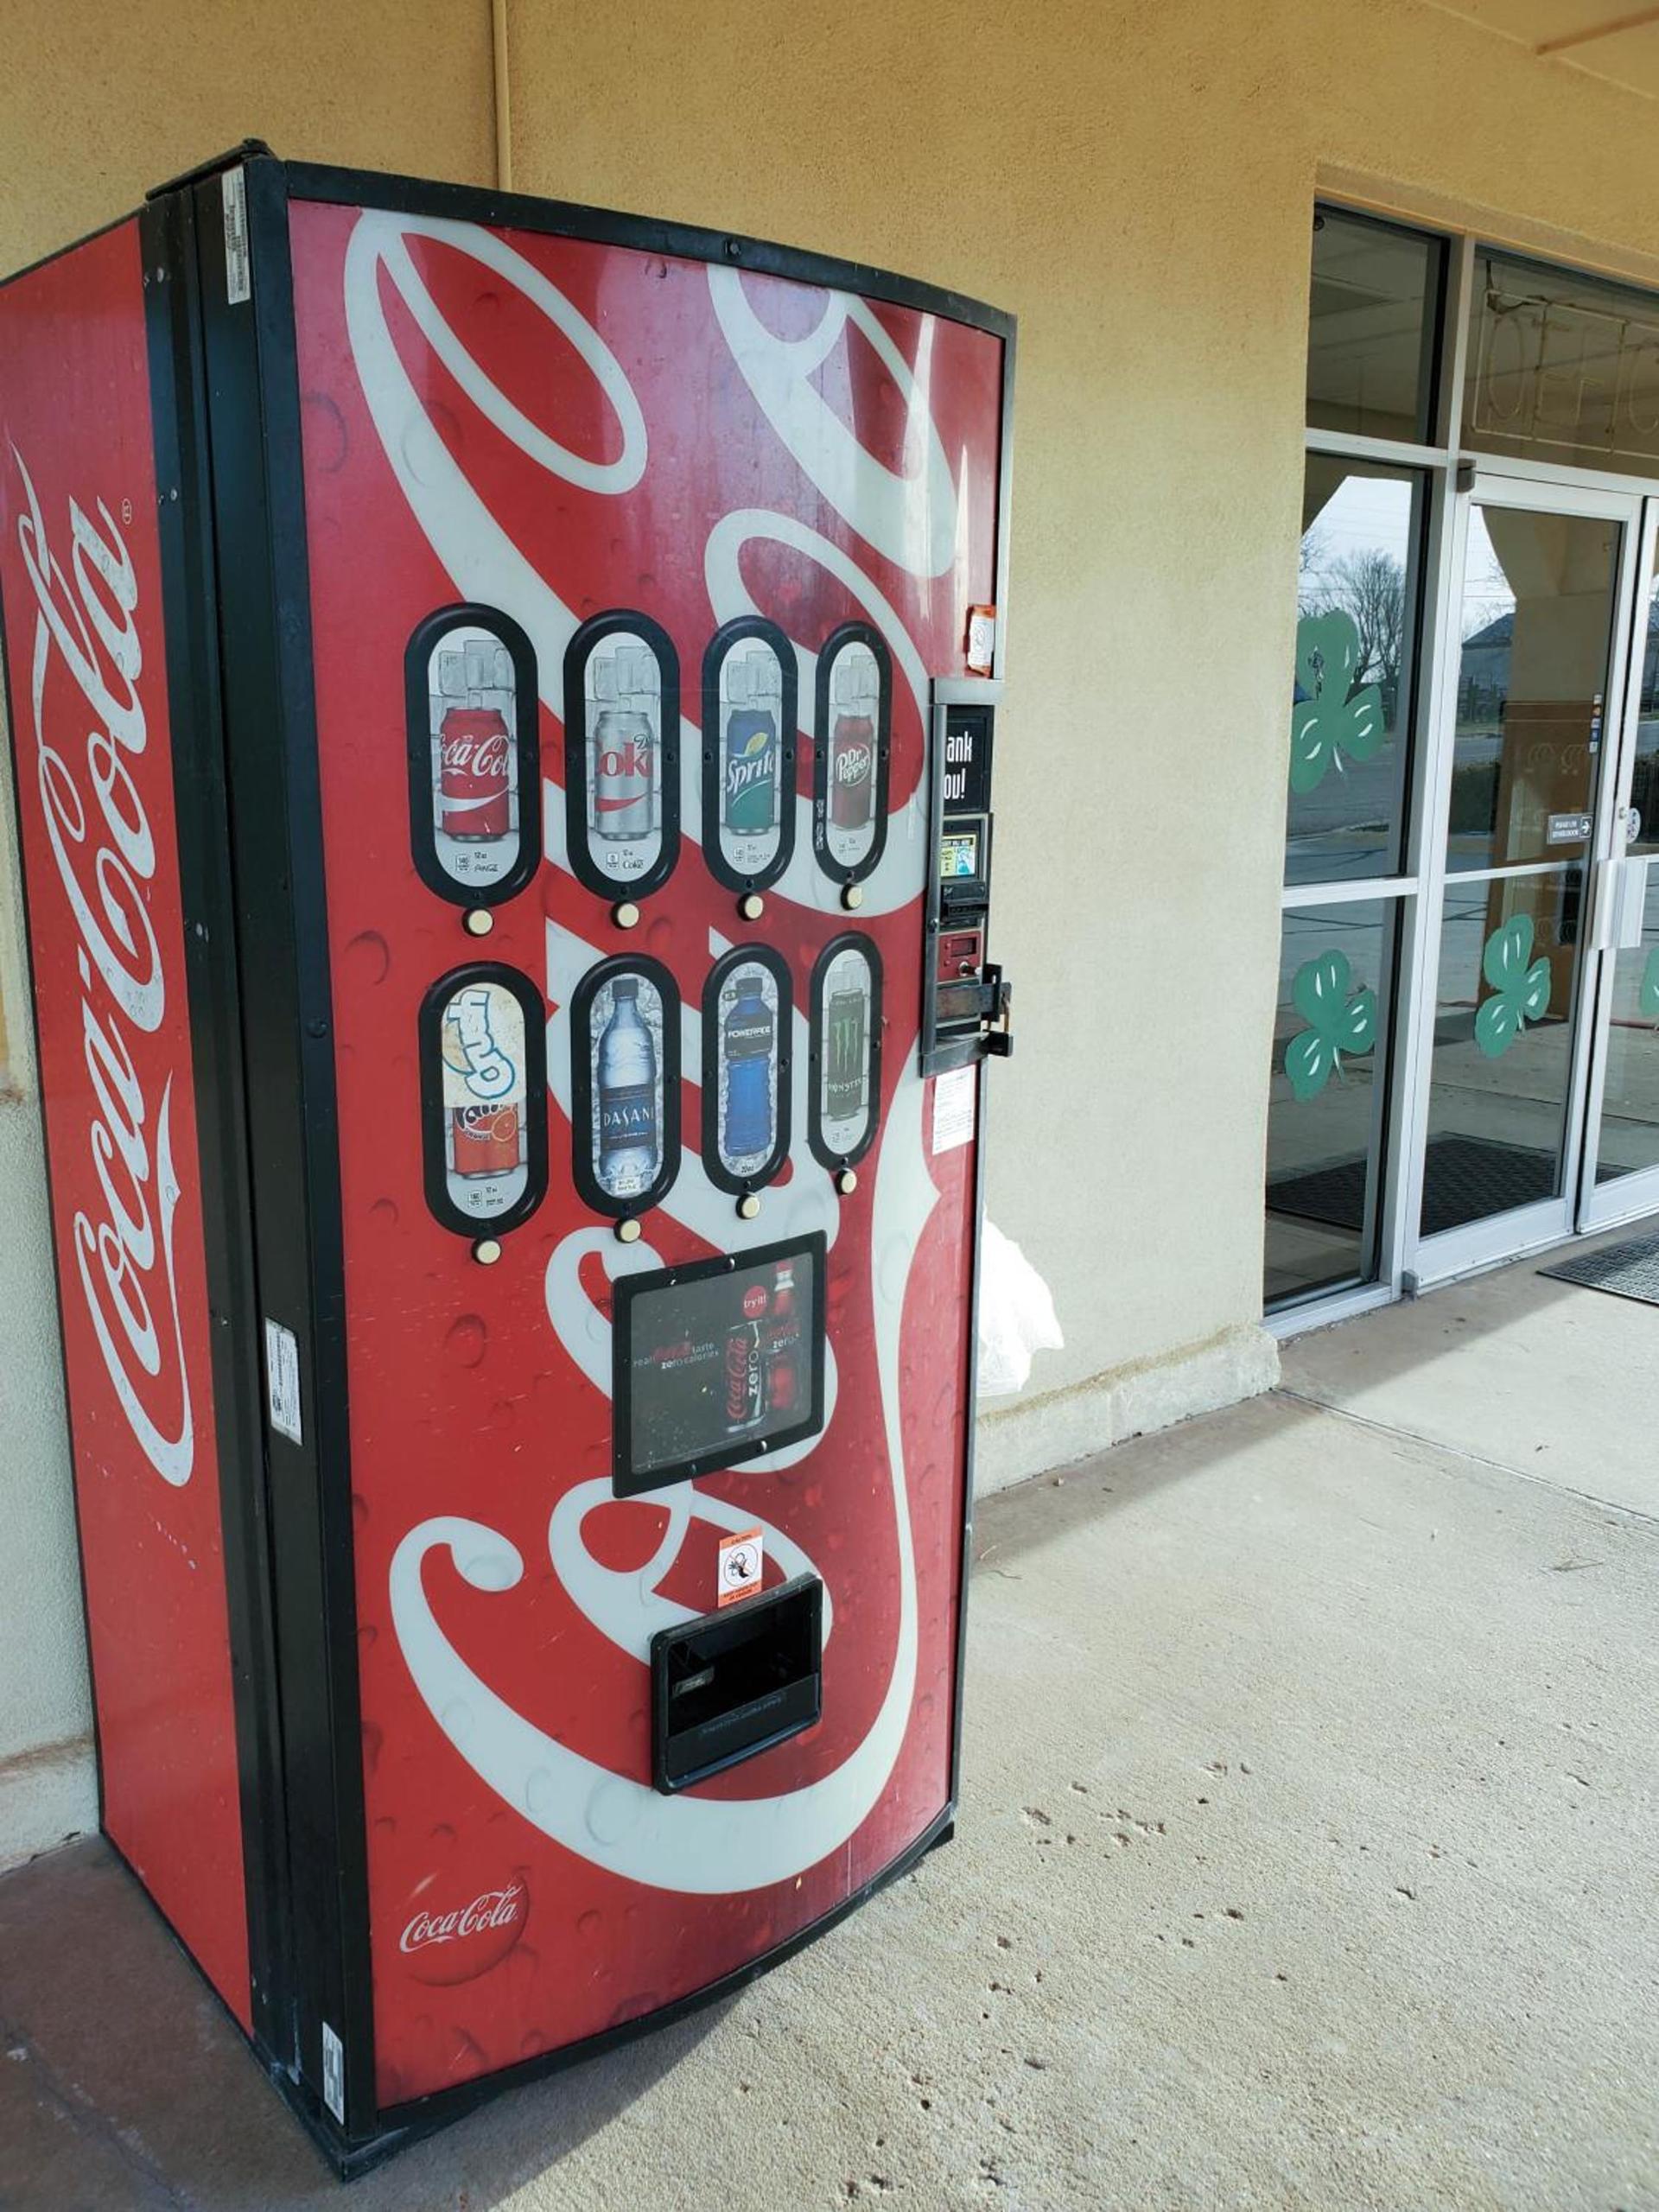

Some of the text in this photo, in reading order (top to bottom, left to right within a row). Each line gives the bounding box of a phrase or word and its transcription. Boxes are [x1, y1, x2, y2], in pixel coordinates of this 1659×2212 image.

[848, 748, 862, 765] Dr
[947, 731, 972, 762] ank
[836, 753, 869, 782] Pepper
[944, 769, 966, 799] ou!
[9, 439, 194, 1488] Coca-Cola
[604, 1106, 654, 1127] DASANI
[748, 1351, 760, 1397] zero
[400, 1885, 523, 1953] Coca-Cola
